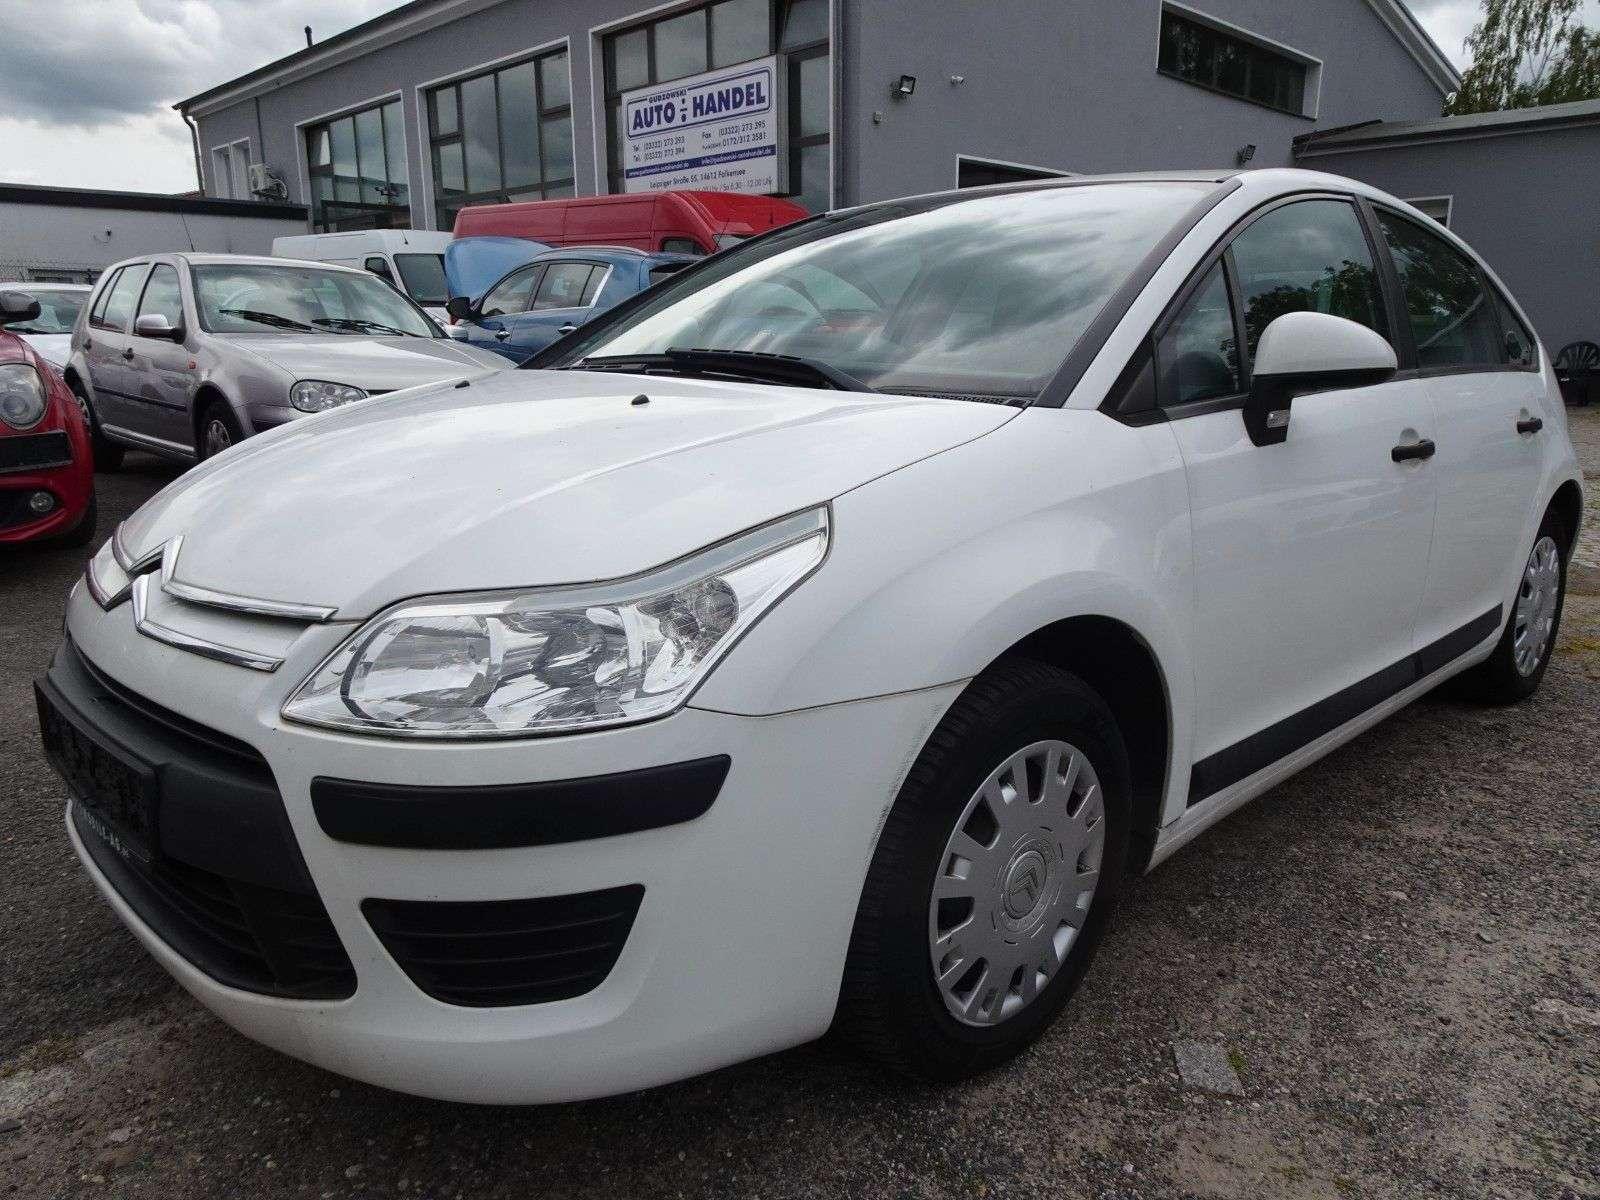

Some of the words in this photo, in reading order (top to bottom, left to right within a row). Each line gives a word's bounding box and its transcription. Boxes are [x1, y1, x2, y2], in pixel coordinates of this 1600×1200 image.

[633, 102, 675, 130] AUTO
[692, 82, 766, 118] HANDEL
[649, 89, 687, 103] GUDZOWSKI
